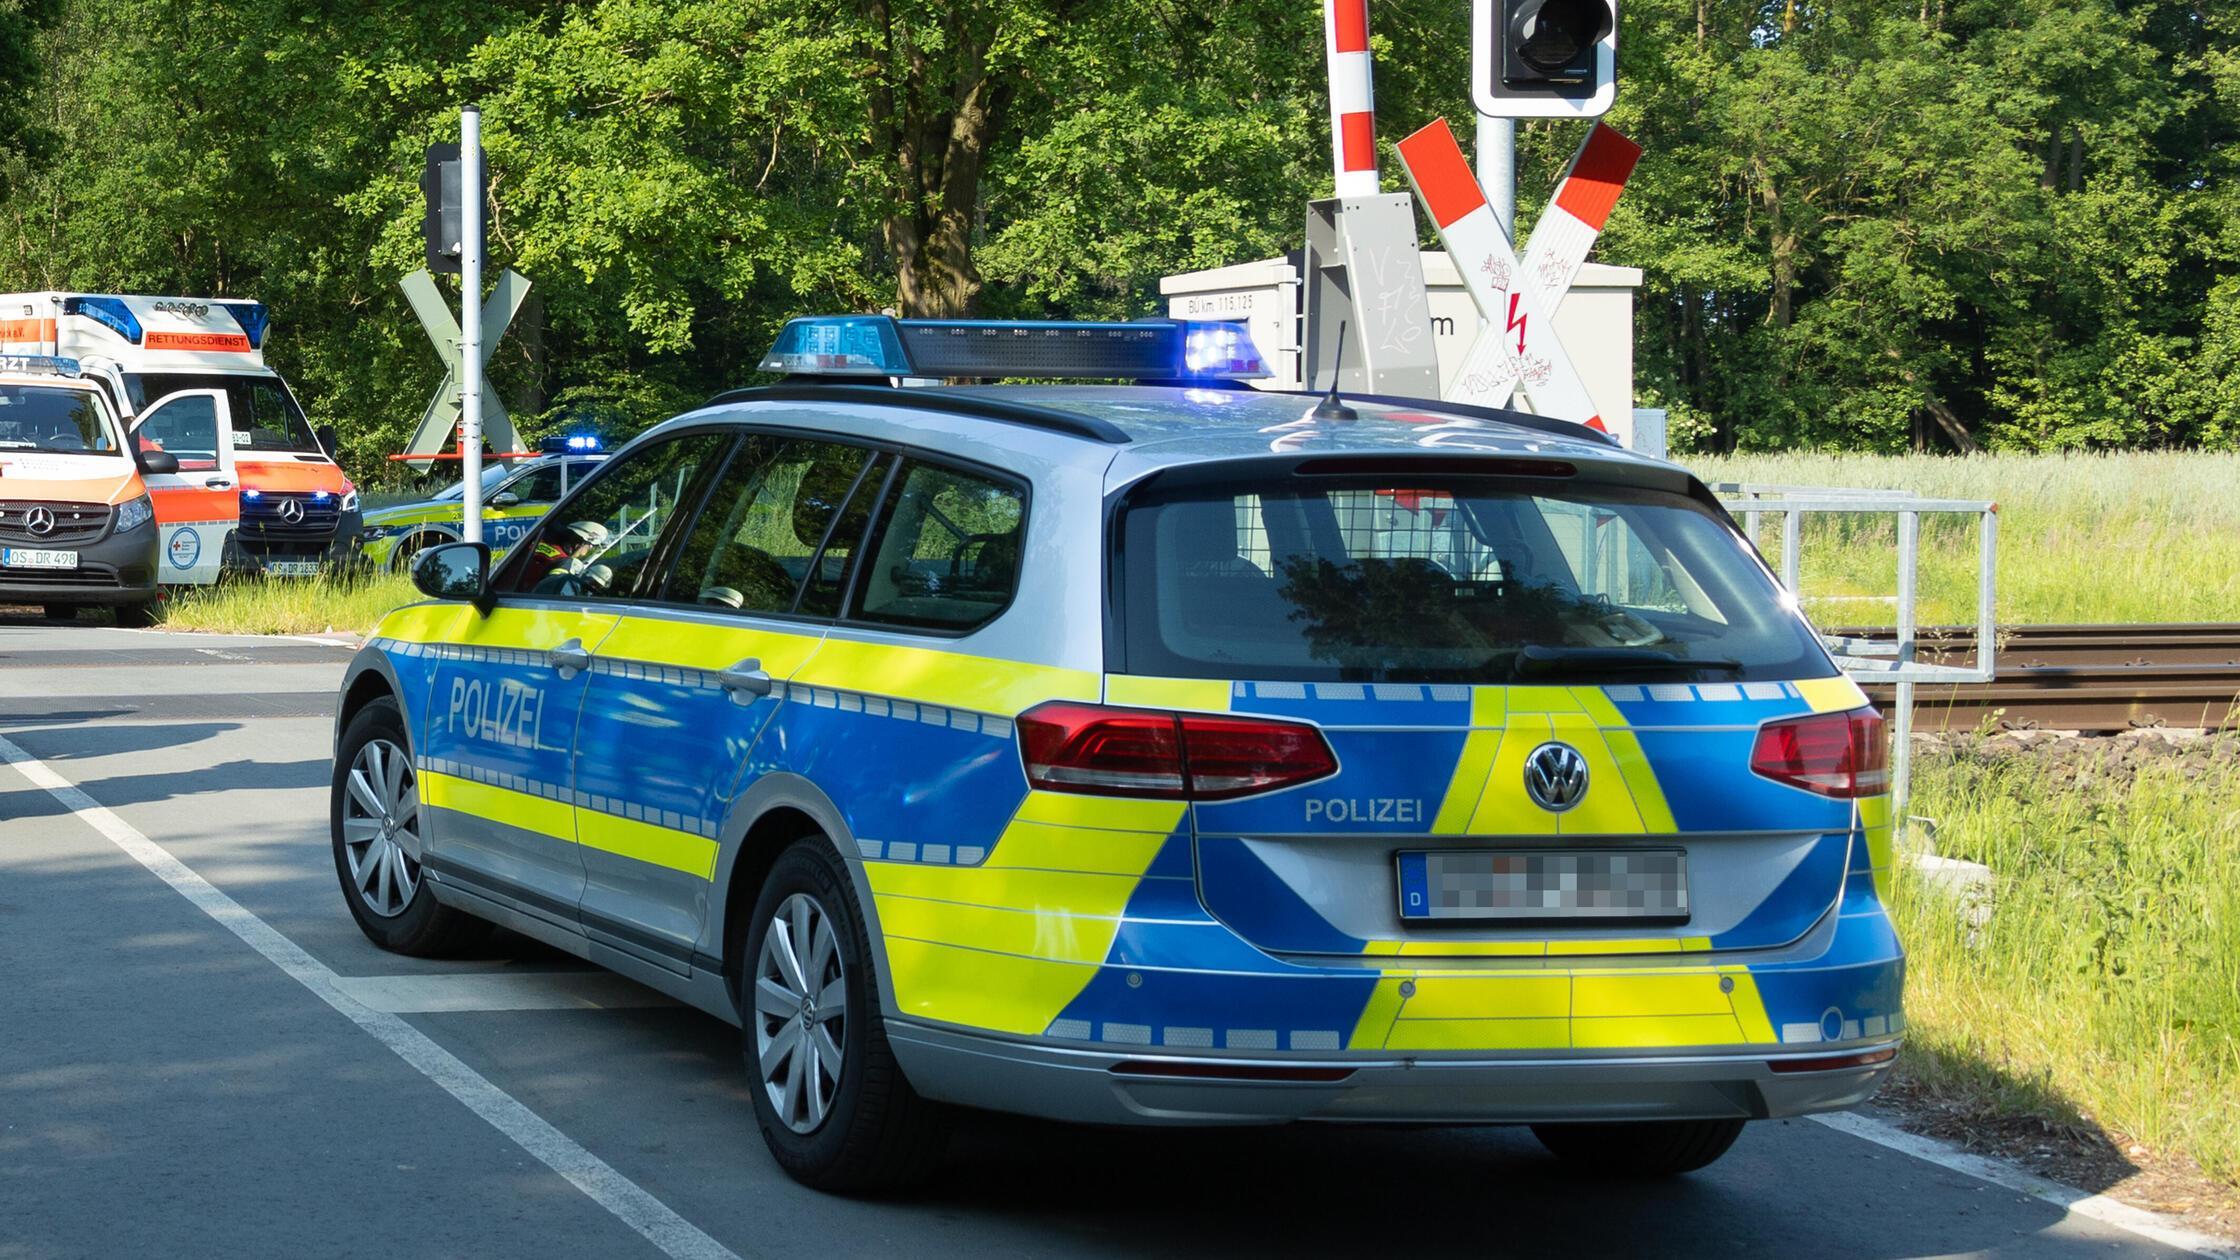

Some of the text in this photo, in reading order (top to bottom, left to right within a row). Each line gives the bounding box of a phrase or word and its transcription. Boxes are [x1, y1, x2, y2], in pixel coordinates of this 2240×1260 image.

[1189, 294, 1253, 314] BÜ km 115,125
[148, 334, 246, 347] RETTUNGSDIENST
[11, 551, 76, 565] OS DR 498
[272, 563, 283, 573] OS
[288, 563, 298, 573] DR
[448, 676, 545, 751] POLIZEI
[1305, 798, 1422, 822] POLIZEI
[1410, 892, 1421, 906] D
